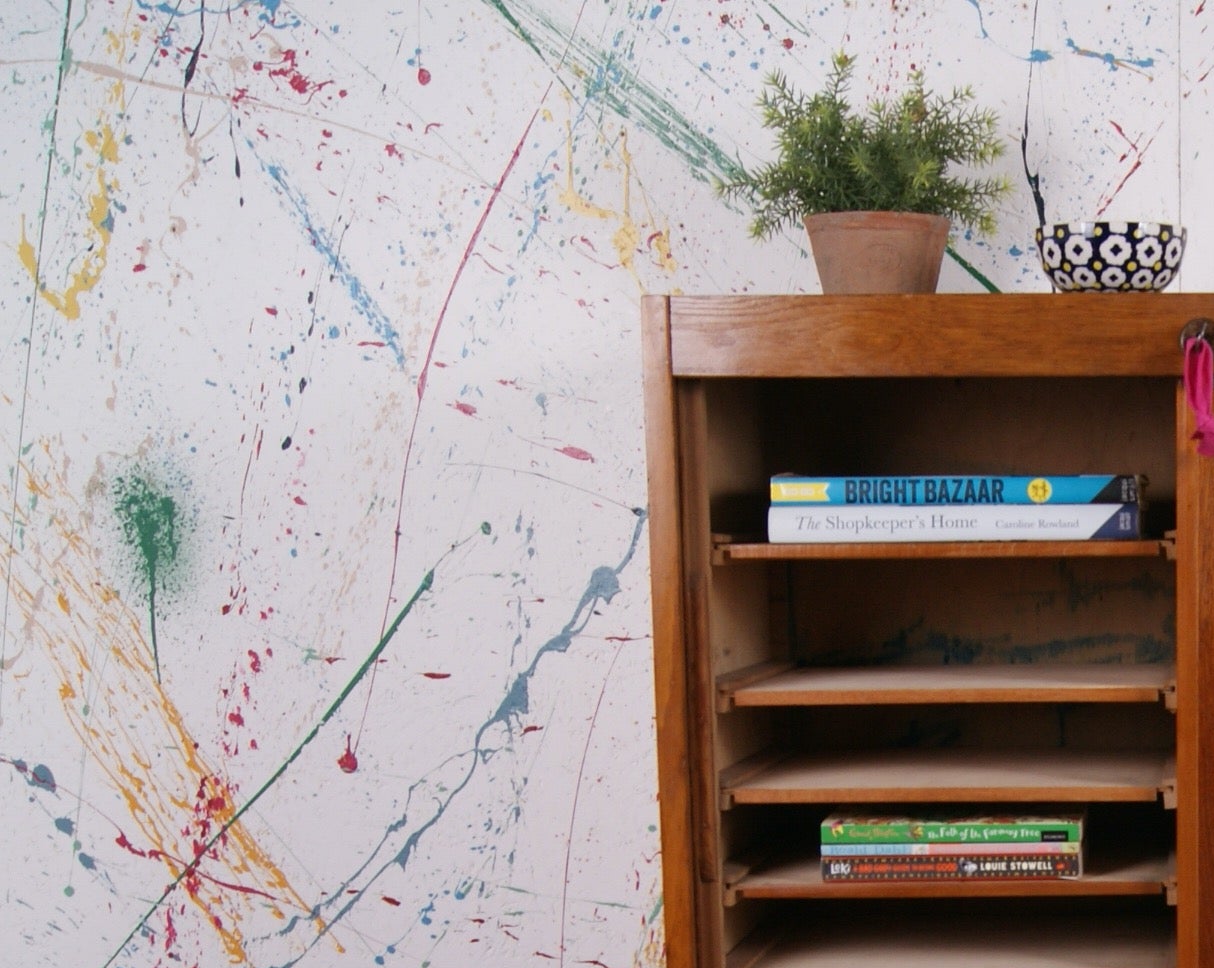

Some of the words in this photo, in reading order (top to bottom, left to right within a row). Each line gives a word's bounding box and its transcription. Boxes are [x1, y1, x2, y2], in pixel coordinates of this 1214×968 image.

[845, 479, 920, 504] BRIGHT
[924, 478, 1005, 503] BAZAAR
[796, 515, 821, 531] The
[825, 515, 927, 534] Shopkeeper's
[931, 515, 978, 530] Home
[995, 519, 1034, 530] Caroline
[1038, 518, 1080, 529] Rowland
[959, 828, 969, 840] of
[980, 861, 1007, 872] LOUIE
[1010, 861, 1053, 871] STOWELL
